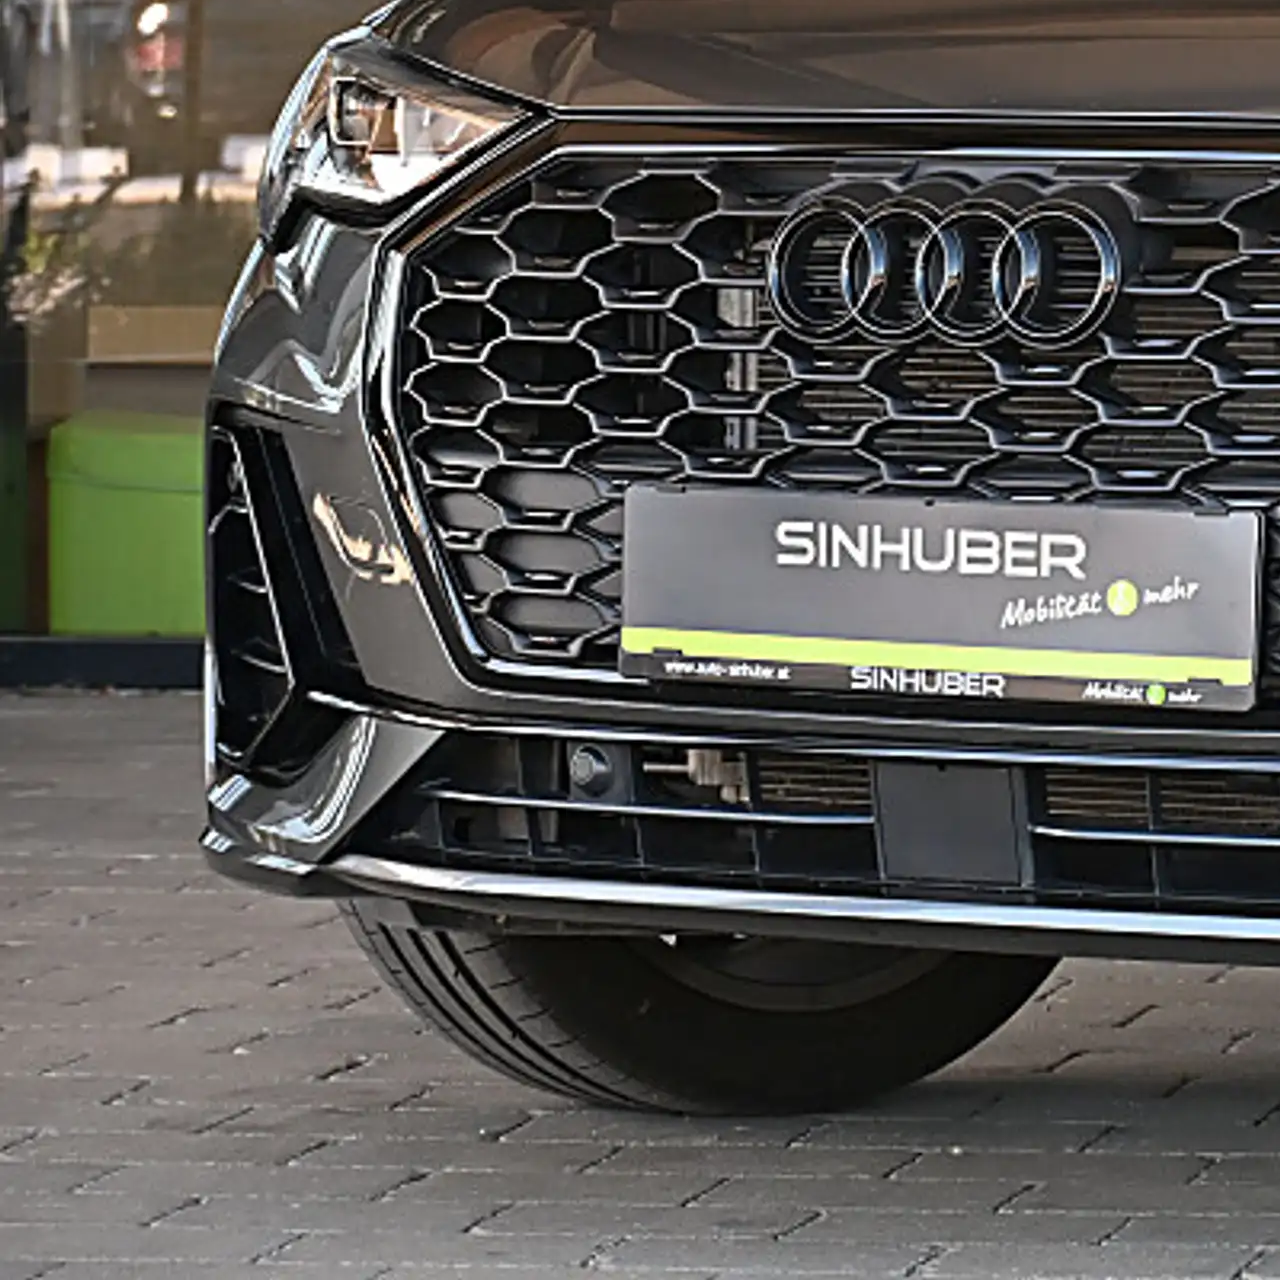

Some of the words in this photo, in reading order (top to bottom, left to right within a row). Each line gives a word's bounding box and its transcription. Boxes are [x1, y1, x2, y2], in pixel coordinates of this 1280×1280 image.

[776, 521, 1087, 579] SINHUBER
[1143, 576, 1200, 605] mehr
[850, 666, 1006, 698] SINHUBER
